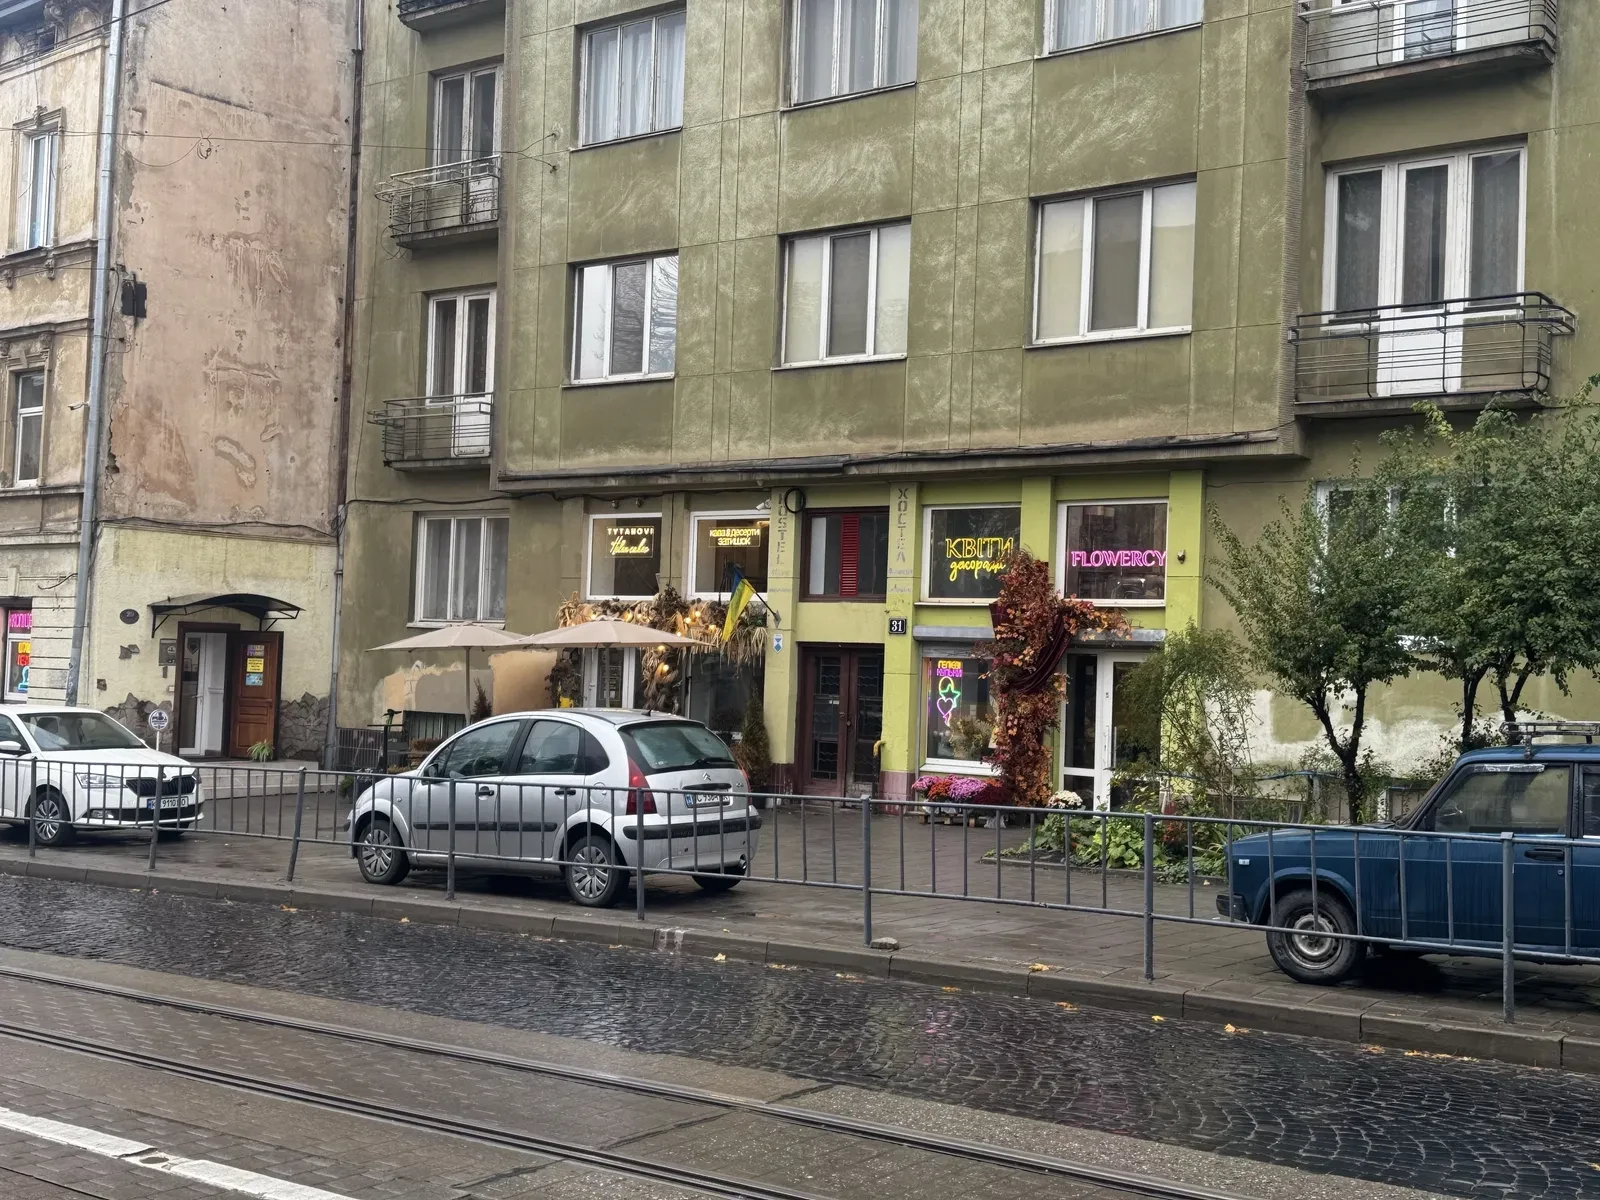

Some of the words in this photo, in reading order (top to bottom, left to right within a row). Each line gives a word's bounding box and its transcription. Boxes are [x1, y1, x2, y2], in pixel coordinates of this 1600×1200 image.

[945, 537, 1014, 559] КВІТИ
[1071, 550, 1167, 567] FLOWERCY
[891, 620, 903, 632] 31
